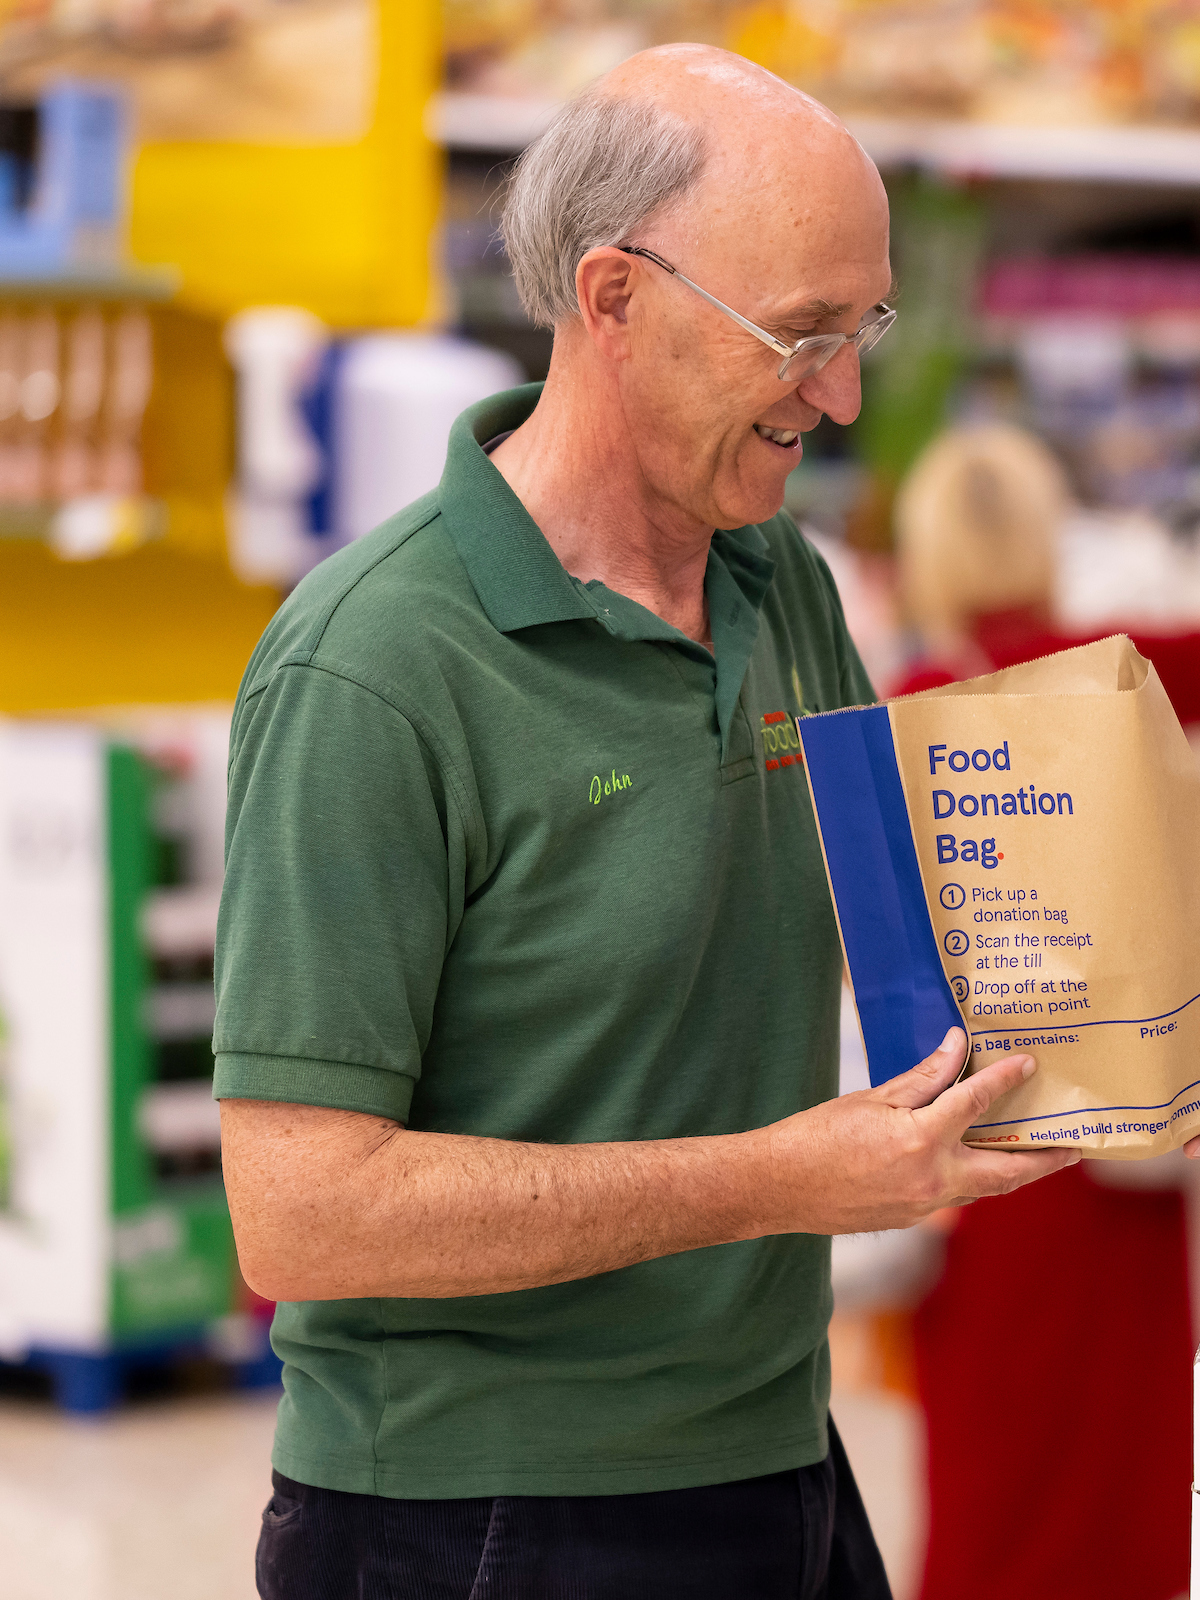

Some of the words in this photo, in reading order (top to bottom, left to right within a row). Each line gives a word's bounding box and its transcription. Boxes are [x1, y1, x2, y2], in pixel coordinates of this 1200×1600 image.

[928, 740, 1011, 776] Food
[589, 769, 632, 804] John
[932, 784, 1074, 820] Donation
[936, 833, 1005, 870] Bag.
[972, 886, 1003, 902] Pick
[1007, 889, 1026, 904] up
[1030, 889, 1038, 901] a
[973, 906, 1040, 923] donation
[1043, 906, 1069, 925] bag
[975, 934, 1010, 949] Scan
[1014, 932, 1040, 947] the
[1044, 932, 1094, 950] receipt
[976, 955, 990, 970] at
[993, 954, 1019, 969] the
[1023, 953, 1042, 968] till
[974, 980, 1010, 998] Drop
[1014, 979, 1036, 994] off
[1040, 980, 1057, 994] at
[1059, 978, 1088, 993] the
[972, 1000, 1044, 1016] donation
[1047, 997, 1091, 1016] point
[1139, 1020, 1179, 1039] Price:
[985, 1038, 1012, 1051] bag
[1014, 1033, 1080, 1047] contains:
[1030, 1128, 1080, 1141] Helping
[1081, 1122, 1113, 1136] build
[1116, 1120, 1169, 1135] stronger
